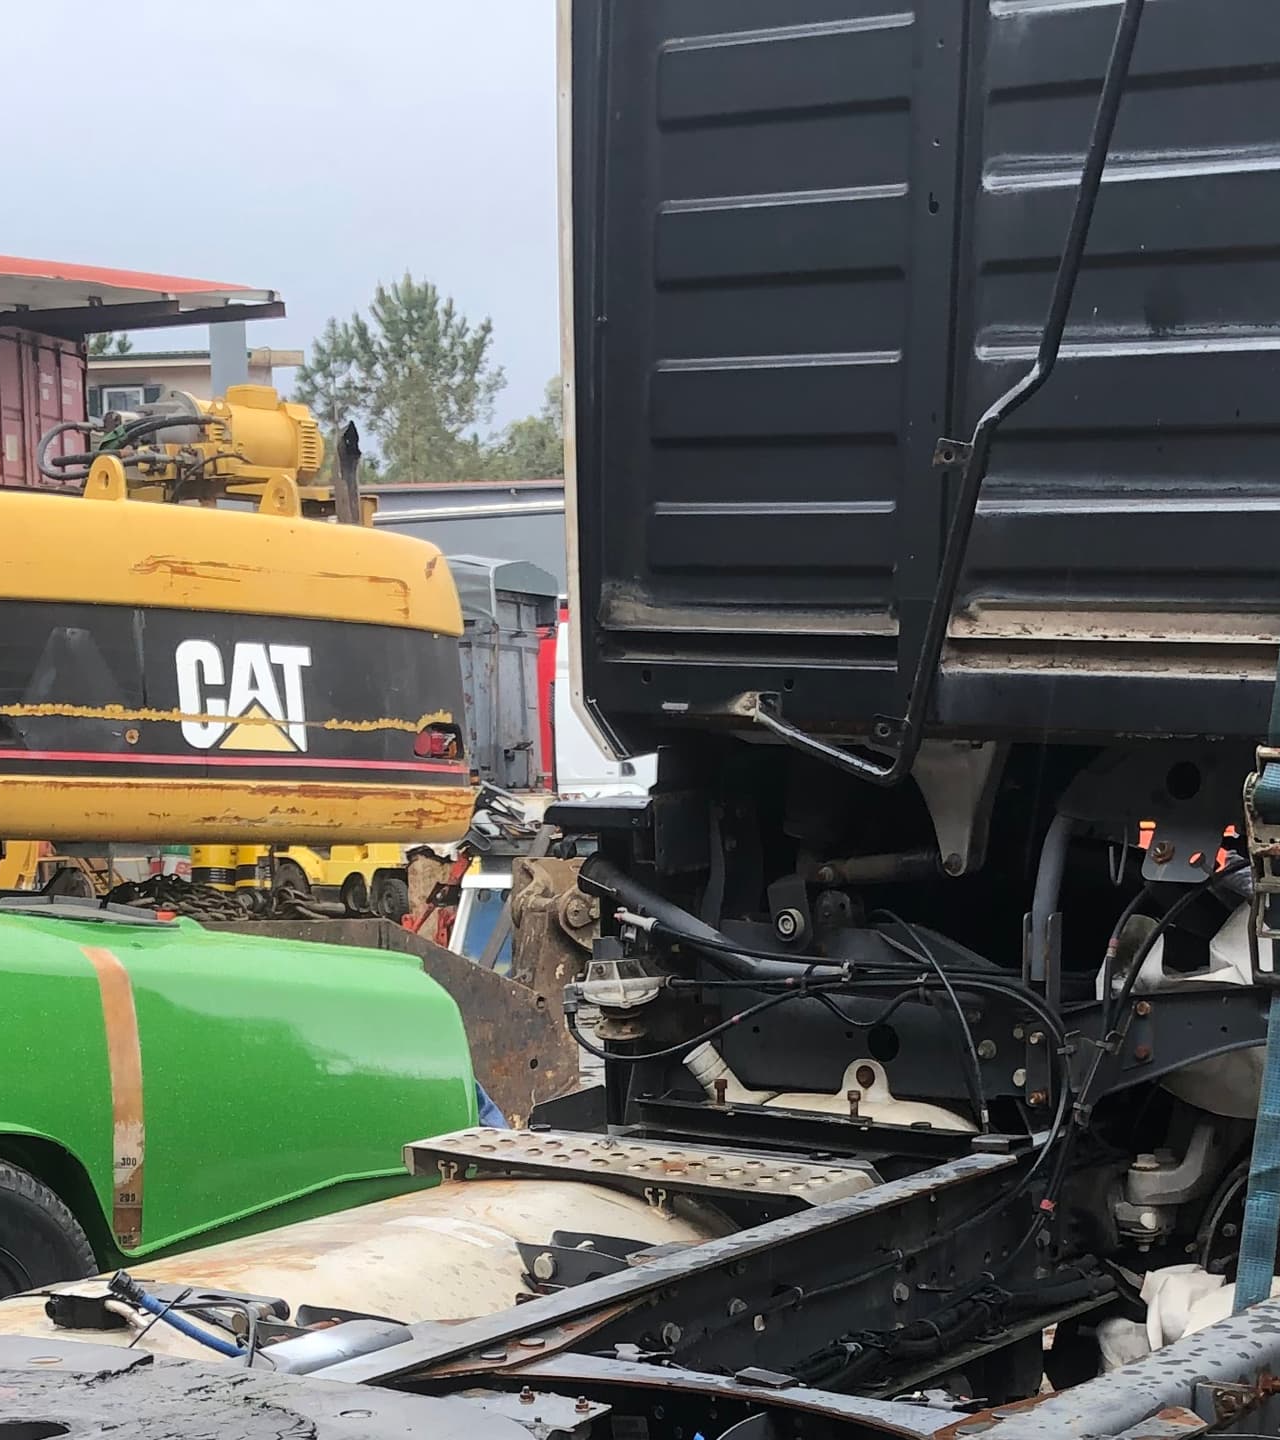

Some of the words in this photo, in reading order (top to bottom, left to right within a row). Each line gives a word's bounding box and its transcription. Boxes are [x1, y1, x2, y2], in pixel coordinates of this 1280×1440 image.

[175, 639, 313, 753] CAT
[120, 1157, 137, 1167] 300
[119, 1192, 136, 1202] 200
